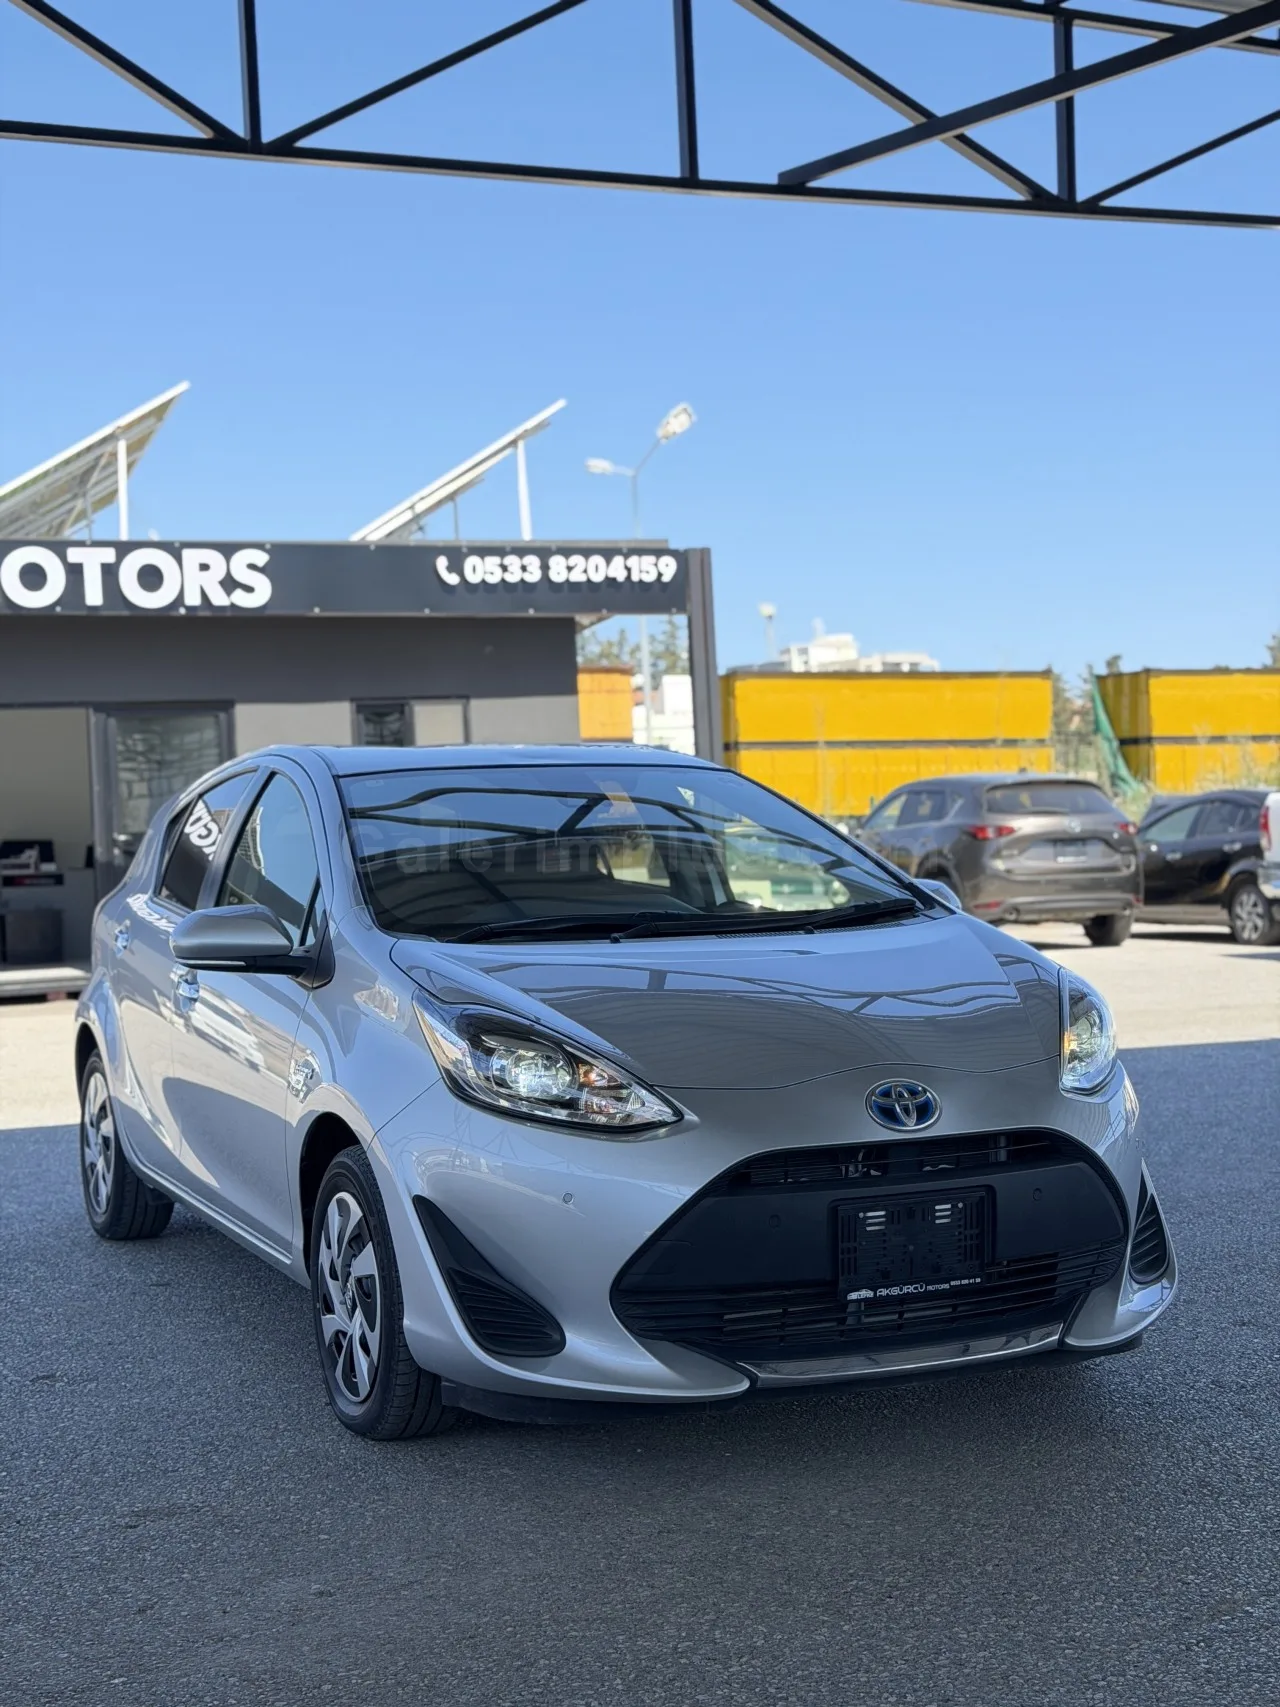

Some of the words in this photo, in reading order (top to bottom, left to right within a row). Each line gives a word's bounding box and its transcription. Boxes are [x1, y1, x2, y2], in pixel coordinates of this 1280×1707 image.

[0, 545, 272, 609] OTORS
[463, 554, 543, 584] 0533
[548, 554, 678, 583] 8204159
